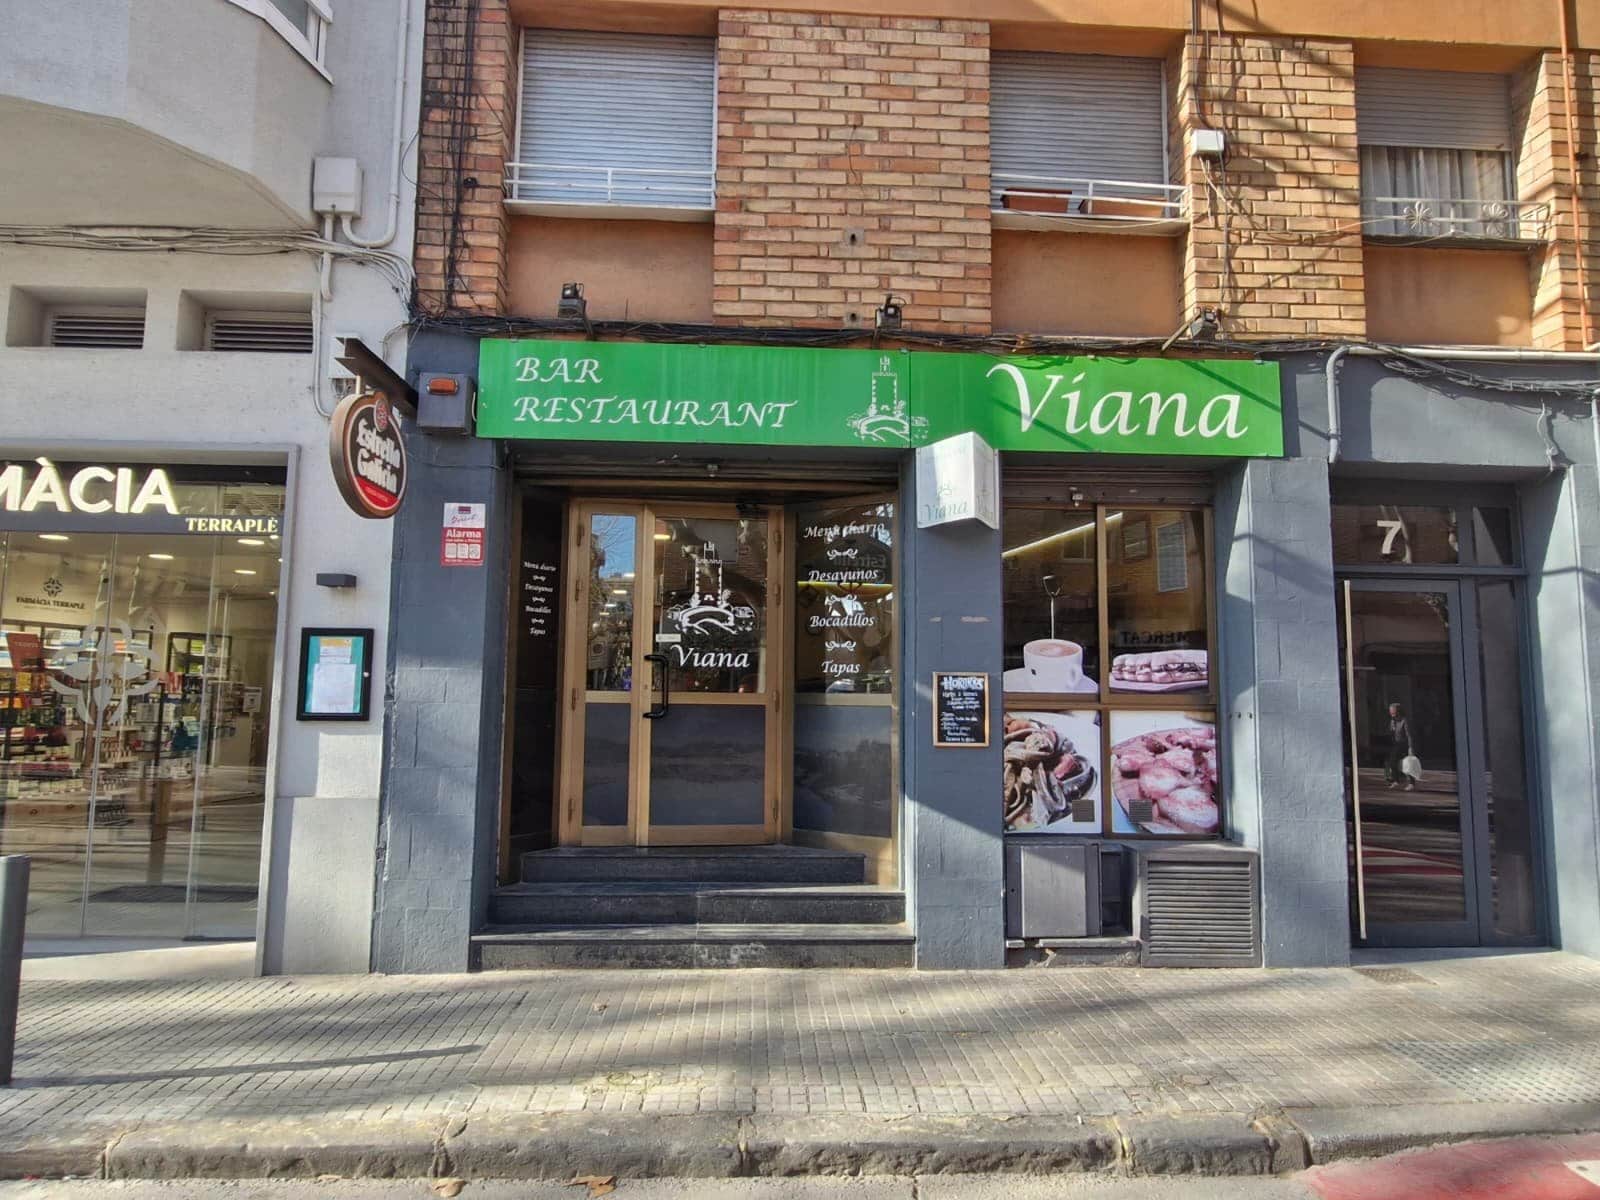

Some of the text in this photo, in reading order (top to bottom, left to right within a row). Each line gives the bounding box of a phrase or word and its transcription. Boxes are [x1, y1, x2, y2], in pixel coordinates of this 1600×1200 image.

[514, 357, 603, 383] BAR
[513, 395, 798, 428] RESTAURANT
[985, 363, 1248, 439] Viana
[356, 418, 400, 469] Estrella
[357, 447, 398, 494] Galicia
[446, 528, 482, 538] Alarma
[1376, 519, 1402, 554] 7
[808, 568, 879, 584] Desayunos
[810, 613, 875, 628] Bocadillos
[670, 644, 750, 668] Viana
[821, 660, 861, 678] Tapas
